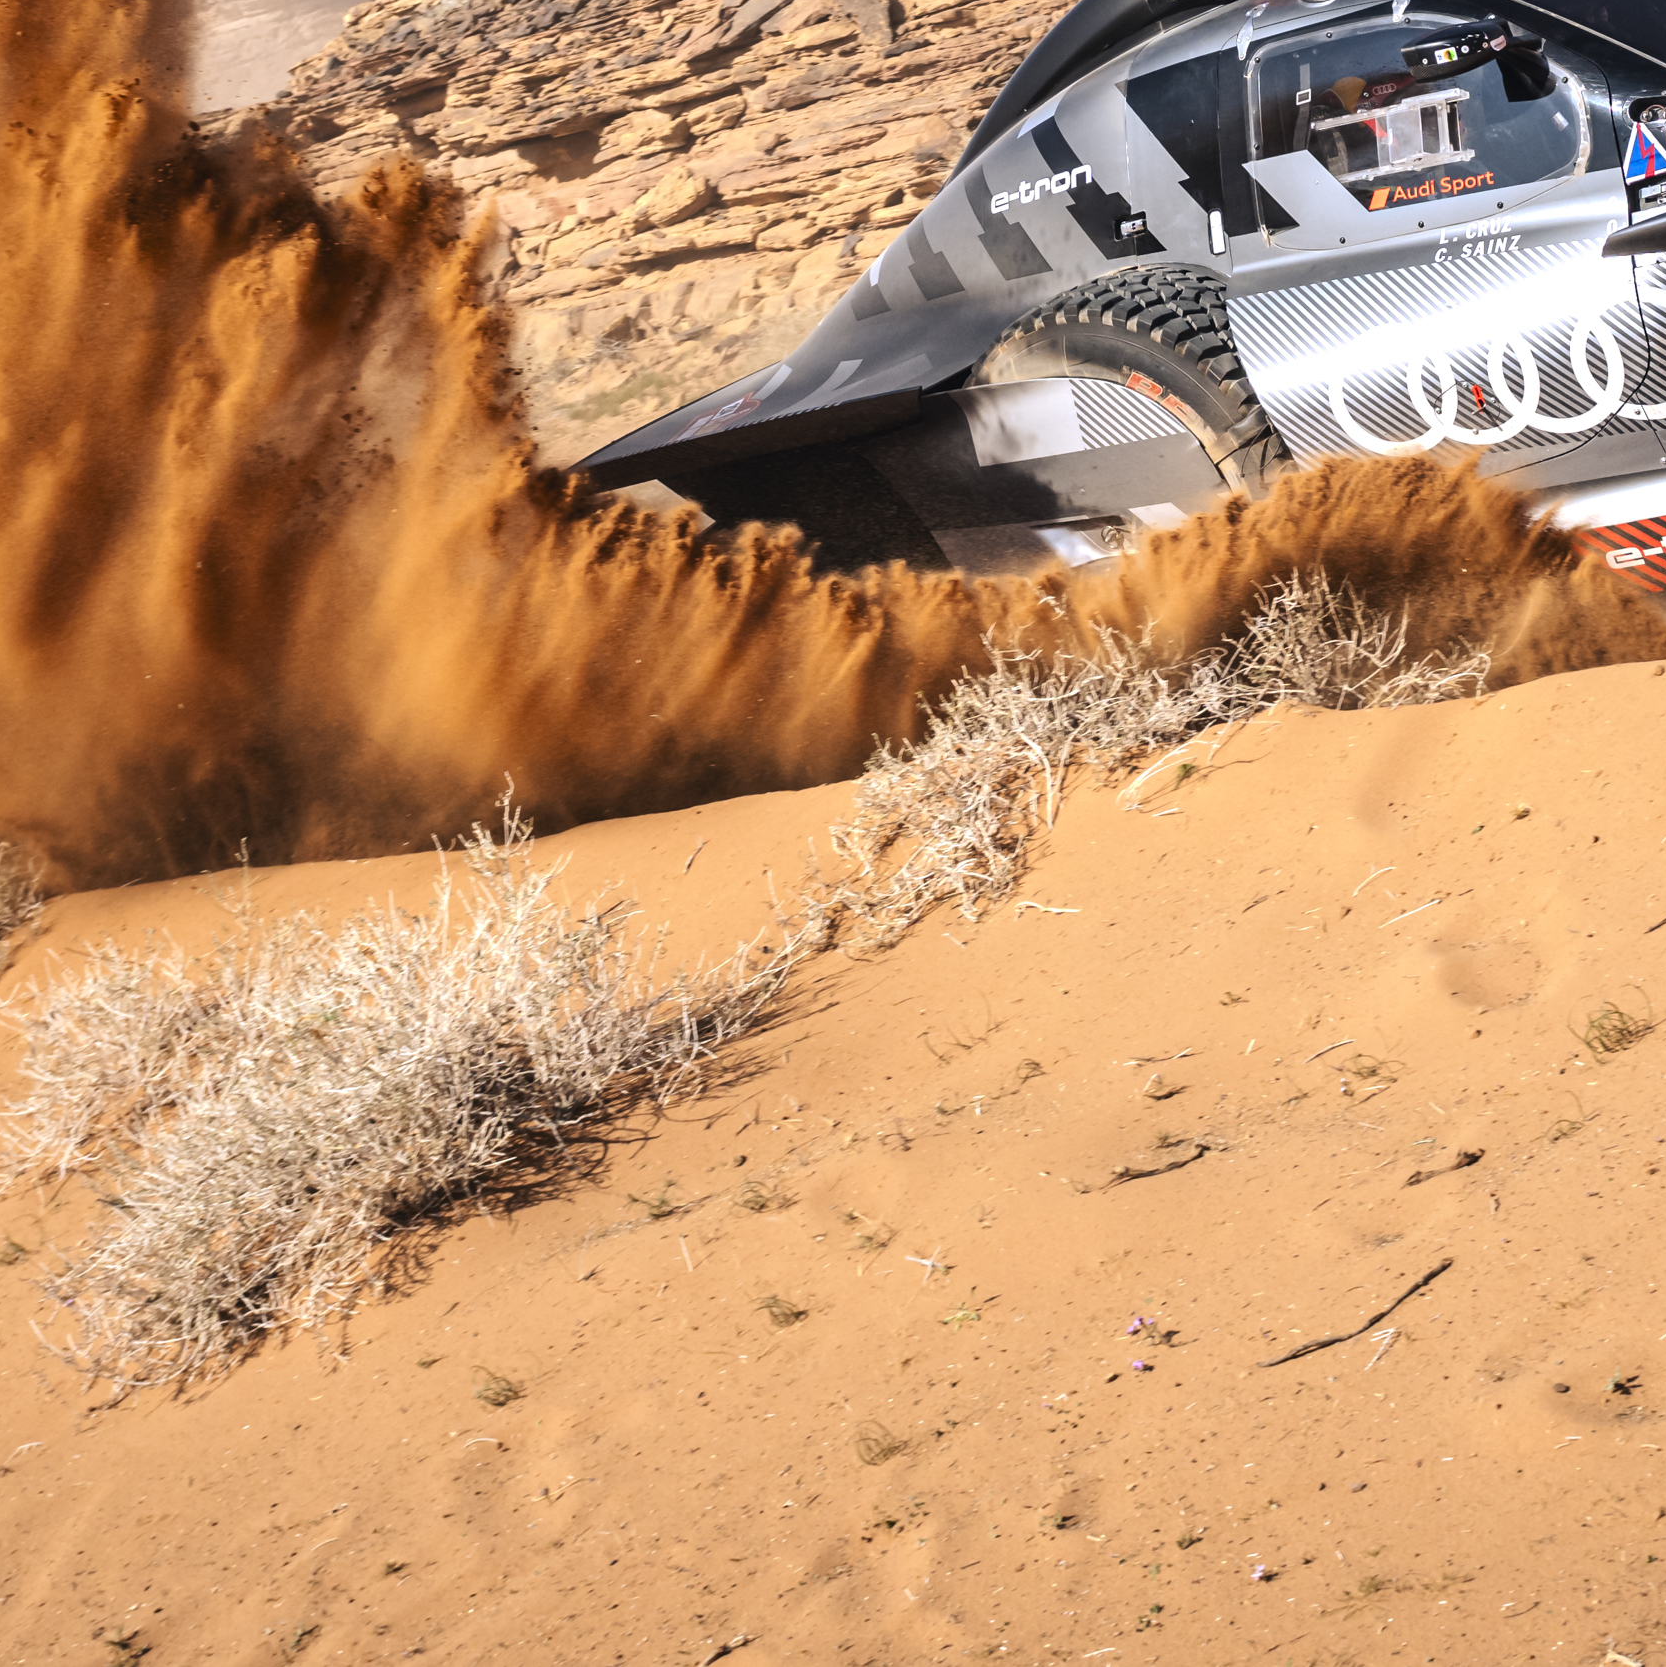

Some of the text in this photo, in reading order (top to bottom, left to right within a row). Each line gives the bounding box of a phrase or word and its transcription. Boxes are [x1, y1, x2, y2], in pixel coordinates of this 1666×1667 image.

[990, 164, 1093, 215] e-tron
[1393, 171, 1495, 203] Audi Sport
[1439, 215, 1513, 245] L. CRUZ
[1434, 235, 1522, 263] C. SAINZ
